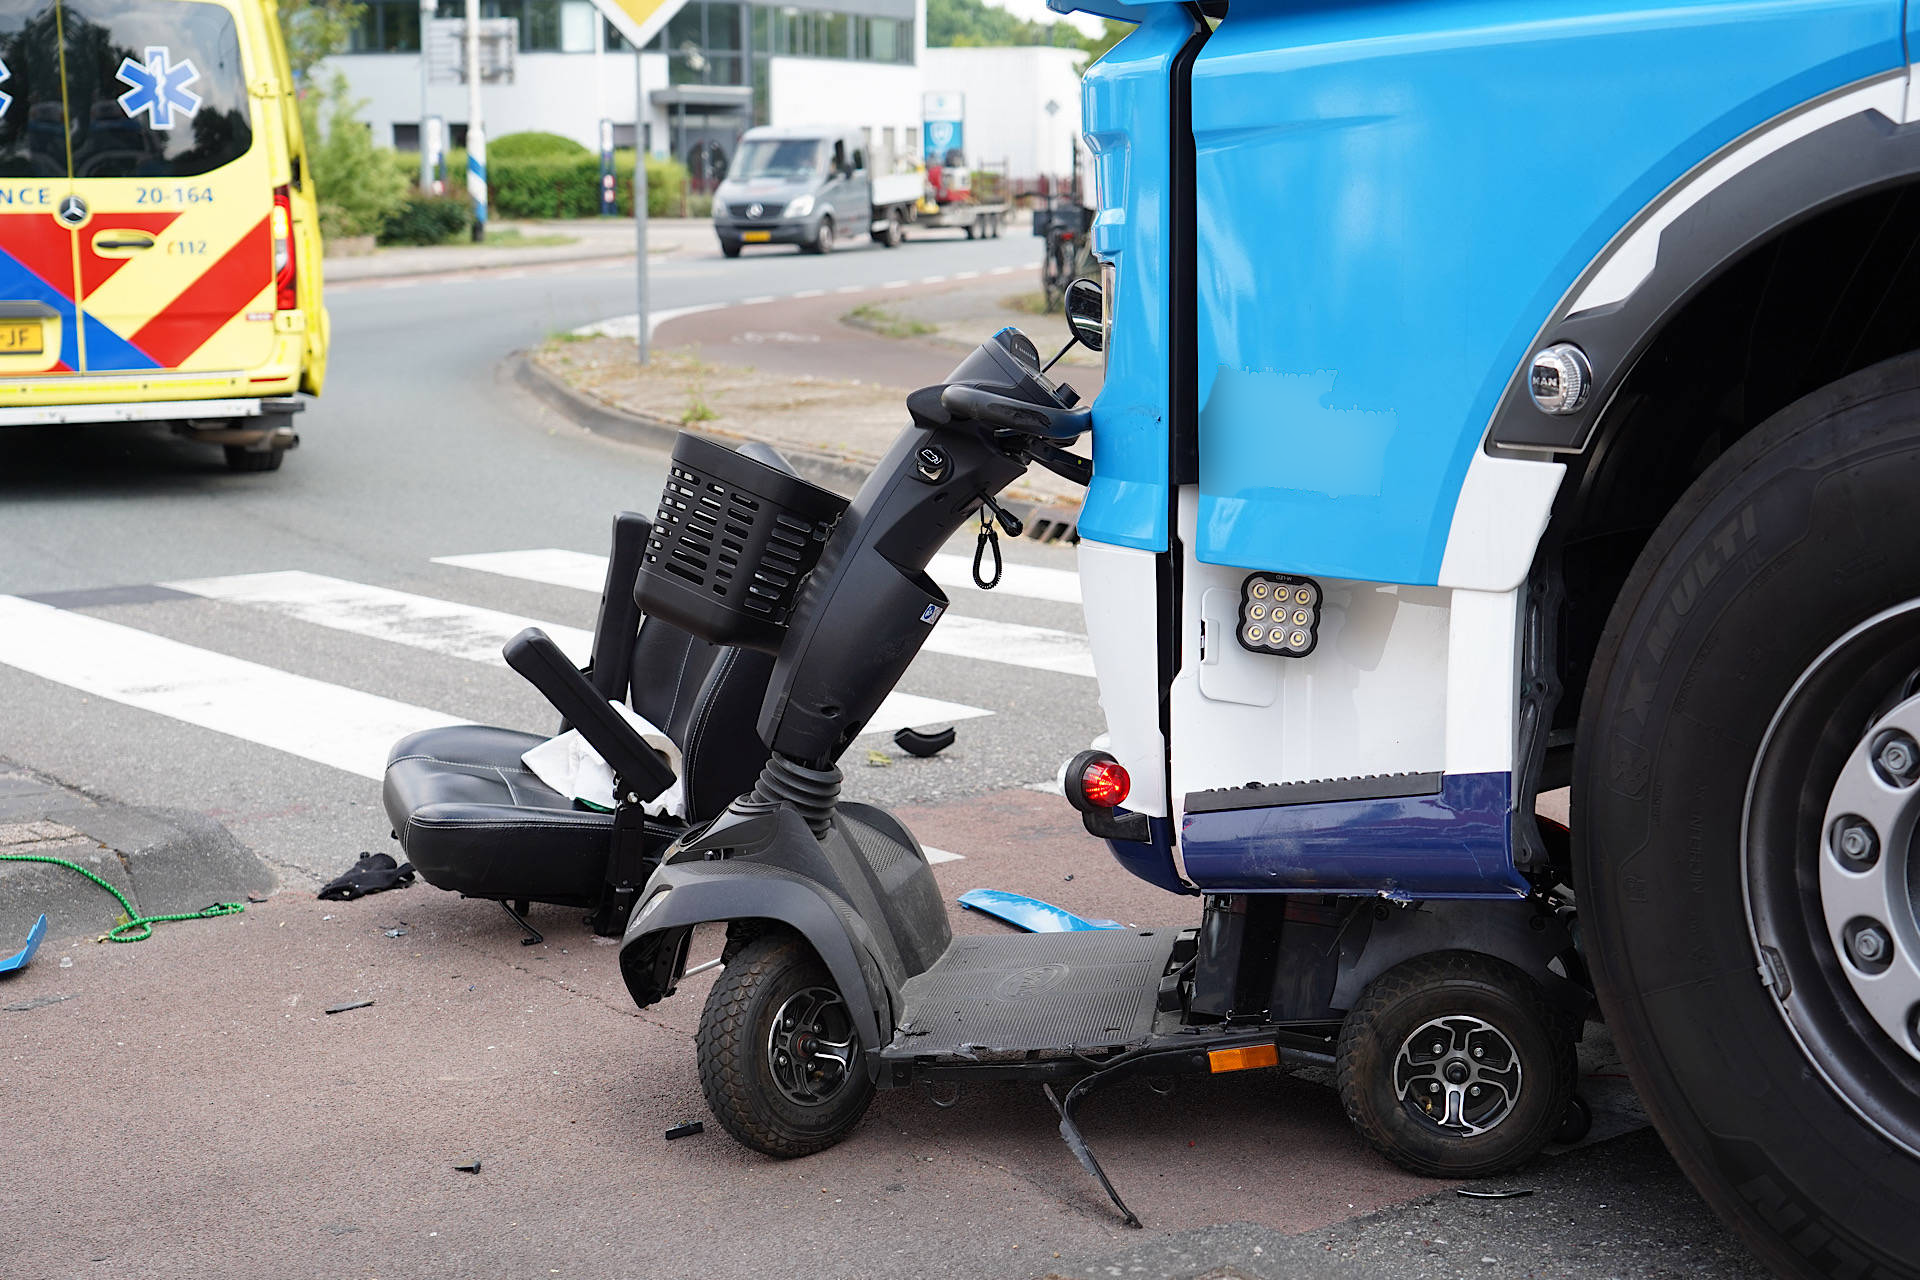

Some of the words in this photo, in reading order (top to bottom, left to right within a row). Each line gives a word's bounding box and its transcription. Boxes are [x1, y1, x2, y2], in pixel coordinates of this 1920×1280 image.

[0, 187, 50, 204] NCE
[136, 187, 213, 204] 20-164
[179, 241, 206, 255] 112
[1532, 376, 1557, 387] MAN
[1645, 505, 1758, 665] MULTI
